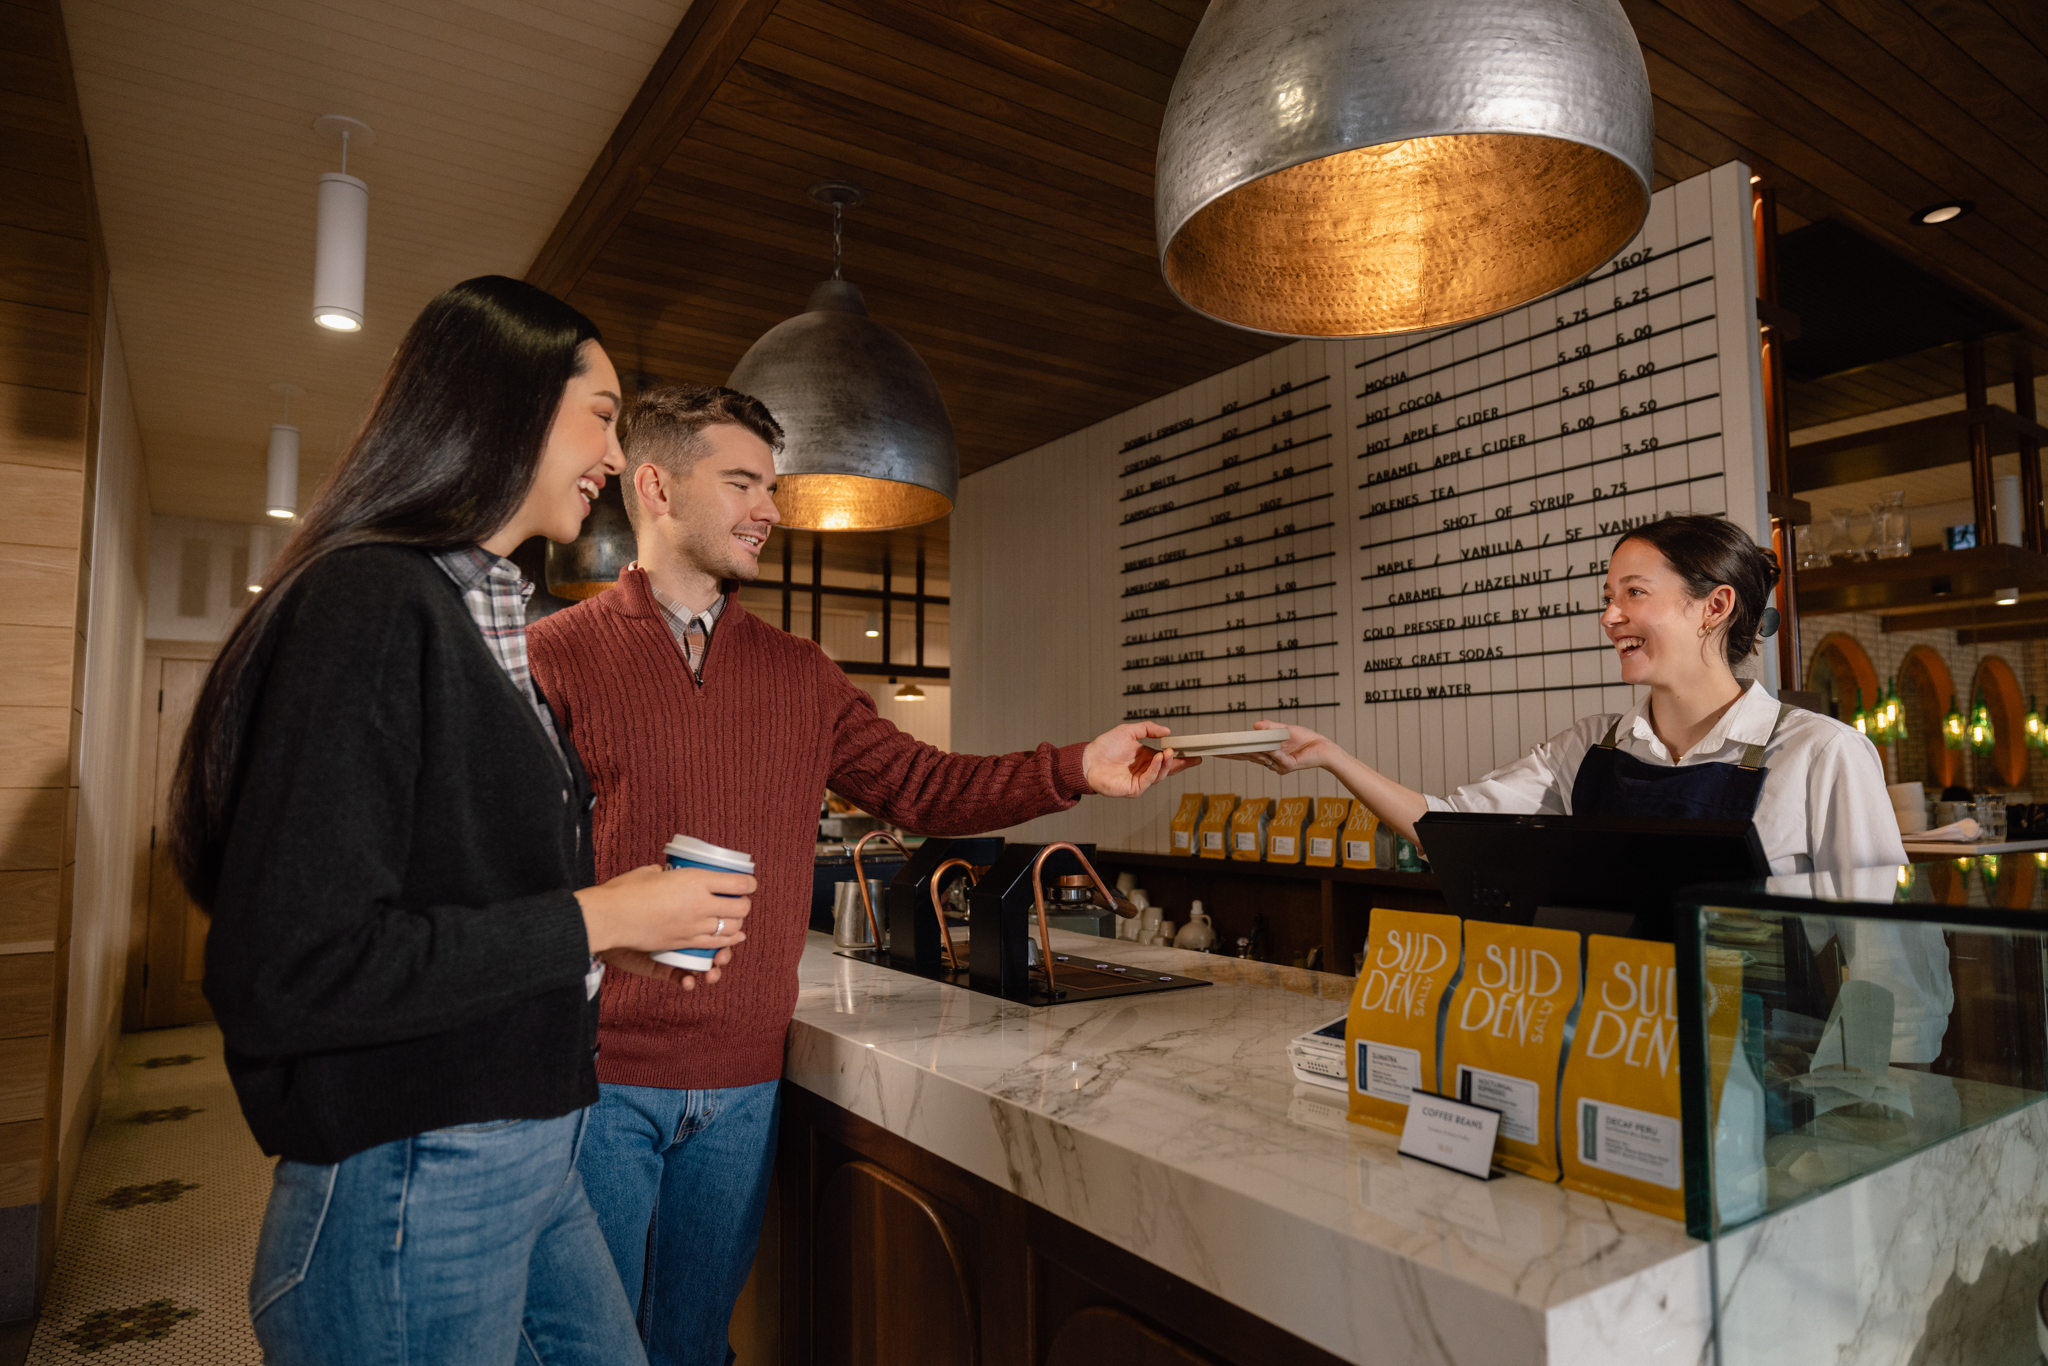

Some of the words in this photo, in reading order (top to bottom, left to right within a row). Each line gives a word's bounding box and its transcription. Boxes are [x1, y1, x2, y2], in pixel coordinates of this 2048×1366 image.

[1613, 247, 1653, 272] 16OZ
[1365, 371, 1407, 394] MOCHA
[1557, 308, 1589, 328] 5.75
[1613, 287, 1650, 309] 6.25
[1366, 407, 1391, 424] HOT
[1399, 391, 1443, 412] COCOA
[1558, 344, 1591, 364] 5.50
[1616, 325, 1652, 345] 6.00
[1366, 438, 1391, 454] HOT
[1403, 424, 1439, 444] APPLE
[1457, 407, 1499, 428] CIDER
[1562, 379, 1594, 399] 5.50
[1619, 362, 1655, 382] 6.00
[1124, 433, 1153, 450] DOUBLE
[1156, 418, 1194, 438] ESPRESSO
[1368, 461, 1421, 484] CARAMEL
[1434, 448, 1473, 468] APPLE
[1482, 434, 1526, 454] CIDER
[1561, 416, 1594, 435] 6.00
[1620, 399, 1657, 420] 6.50
[1124, 455, 1161, 473] CORTADO
[1369, 494, 1419, 515] JOLENES
[1430, 485, 1456, 501] TEA
[1622, 437, 1658, 456] 3.50
[1126, 485, 1145, 497] FLAT
[1150, 475, 1177, 491] WHITE
[1124, 501, 1174, 521] CAPPUCCINO
[1210, 511, 1231, 524] 12OZ
[1260, 498, 1282, 511] 16OZ
[1442, 513, 1478, 531] SHOT
[1495, 506, 1512, 520] OF
[1530, 493, 1575, 513] SYRUP
[1592, 482, 1628, 500] 0.75
[1124, 557, 1154, 571] BREWED
[1158, 549, 1187, 563] COFFEE
[1377, 558, 1415, 575] MAPLE
[1461, 539, 1524, 560] VANILLA
[1566, 527, 1583, 541] SF
[1125, 578, 1170, 595] AMERICANO
[1125, 608, 1150, 619] LATTE
[1226, 591, 1245, 602] 5.50
[1275, 581, 1297, 593] 6.00
[1388, 587, 1445, 605] CARAMEL
[1475, 568, 1552, 593] HAZELNUT
[1126, 631, 1148, 644] CHAI
[1152, 628, 1179, 641] LATTE
[1227, 618, 1246, 629] 5.25
[1276, 611, 1297, 622] 5.75
[1364, 626, 1394, 640] COLD
[1404, 618, 1455, 635] PRESSED
[1460, 612, 1501, 628] JUICE
[1512, 608, 1529, 621] BY
[1538, 601, 1584, 617] WELL
[1126, 656, 1150, 668] DIRTY
[1153, 653, 1175, 665] CHAI
[1178, 650, 1205, 662] LATTE
[1227, 646, 1246, 656] 5.50
[1277, 639, 1299, 650] 6.00
[1365, 657, 1403, 671] ANNEX
[1411, 652, 1451, 667] CRAFT
[1459, 646, 1503, 661] SODAS
[1127, 683, 1146, 693] EARL
[1150, 681, 1169, 692] GREY
[1175, 678, 1202, 689] LATTE
[1227, 674, 1247, 684] 5.25
[1278, 668, 1299, 679] 5.75
[1365, 687, 1421, 702] BOTTLED
[1427, 684, 1472, 697] WATER
[1127, 707, 1161, 718] MATCHA
[1164, 705, 1191, 716] LATTE
[1228, 702, 1247, 712] 5.25
[1278, 698, 1299, 709] 5.75
[1280, 802, 1304, 817] SUD
[1321, 803, 1344, 818] SUD
[1377, 930, 1447, 973] SUD
[1477, 944, 1562, 997] SUD
[1361, 970, 1422, 1021] DEN
[1414, 976, 1434, 1017] SALLY
[1460, 987, 1538, 1047] DEN
[1530, 999, 1554, 1044] SALLY
[1586, 1010, 1678, 1079] DEN
[1421, 1106, 1453, 1123] COFFEE
[1455, 1115, 1484, 1131] BEANS
[1606, 1116, 1633, 1129] DECAF
[1635, 1123, 1659, 1136] PERU
